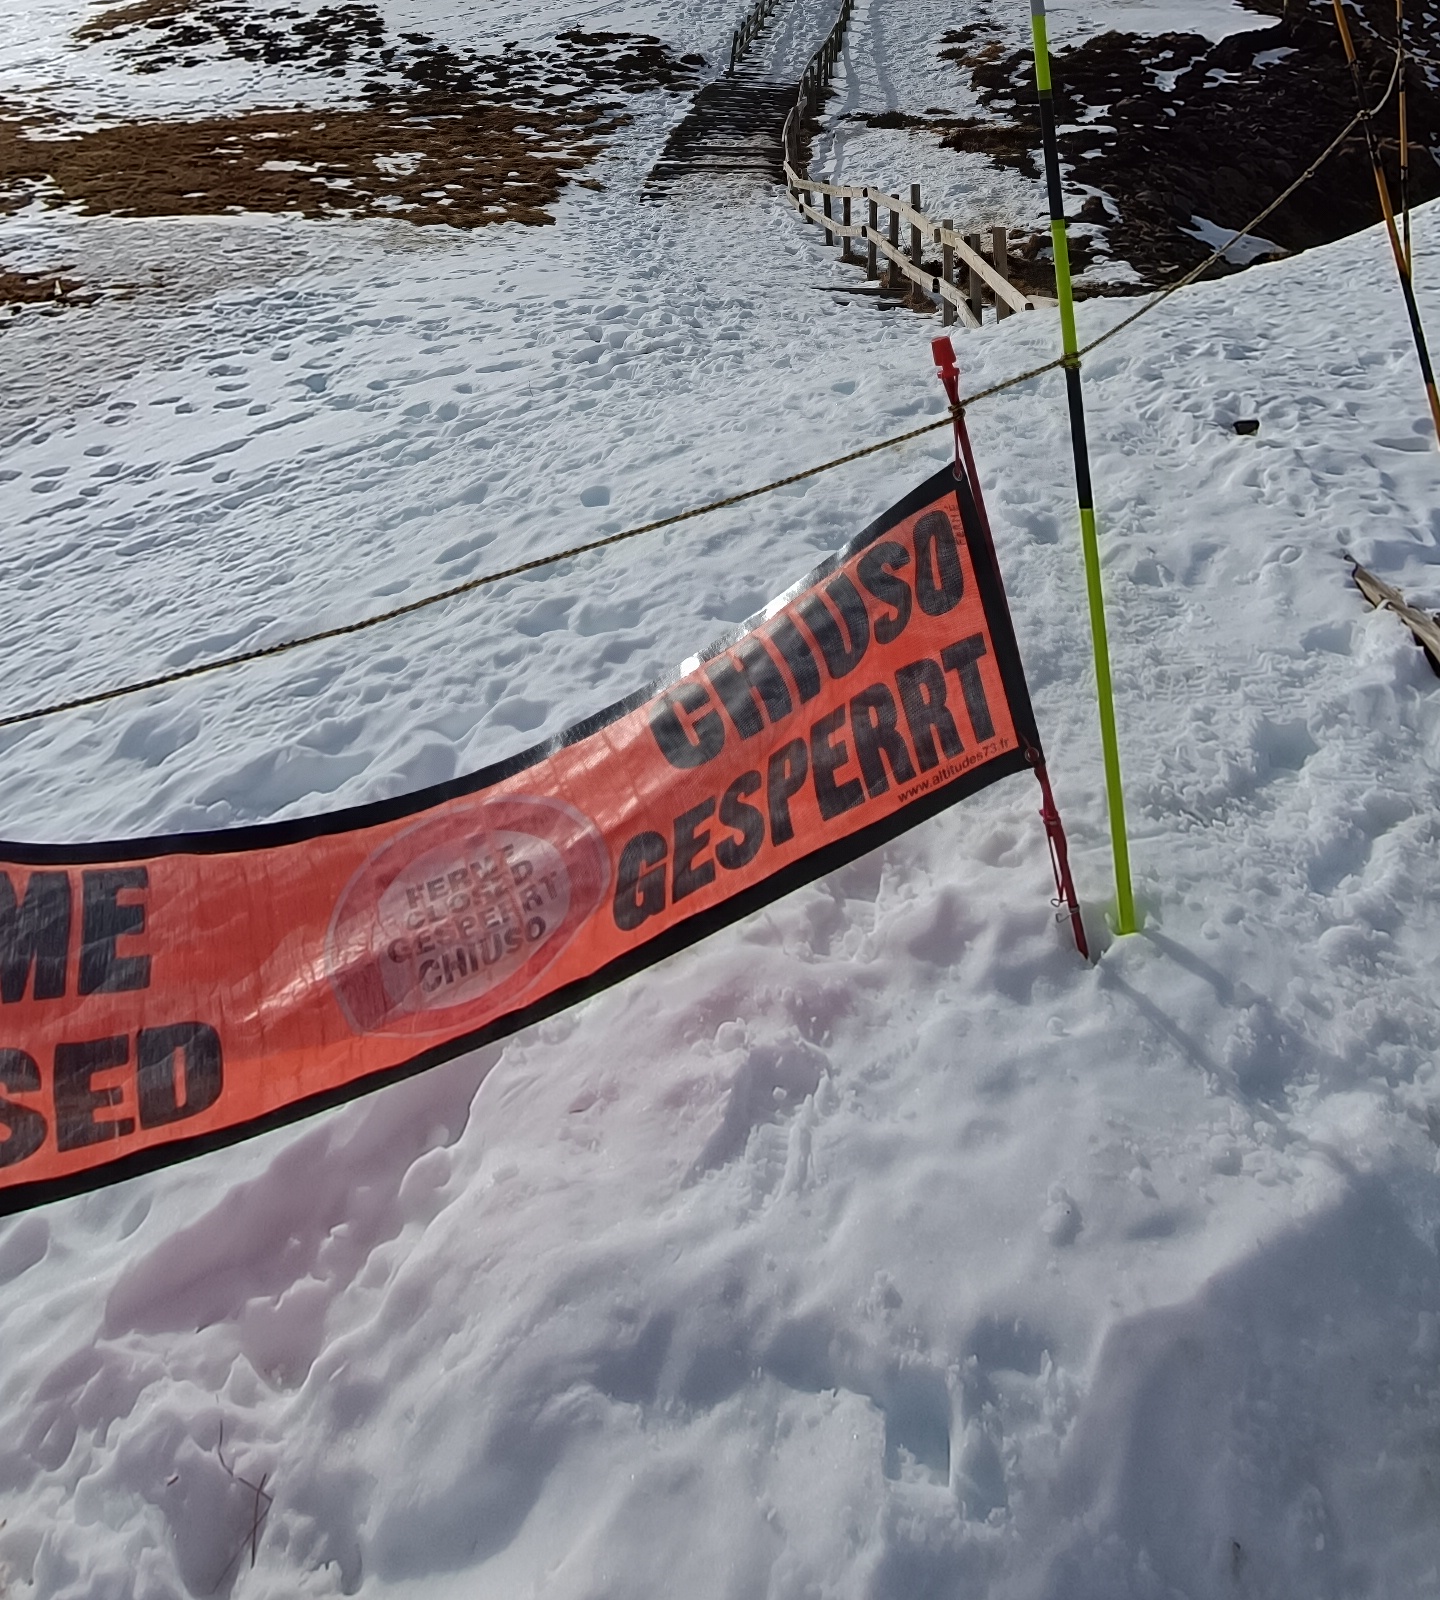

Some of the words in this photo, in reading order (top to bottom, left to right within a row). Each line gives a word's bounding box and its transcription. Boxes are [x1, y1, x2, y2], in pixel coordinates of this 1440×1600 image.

[649, 510, 964, 769] CHIUSO
[612, 632, 996, 932] GESPERRT
[897, 737, 1010, 803] www.altitudes73.fr
[418, 916, 546, 993] CHIUSO
